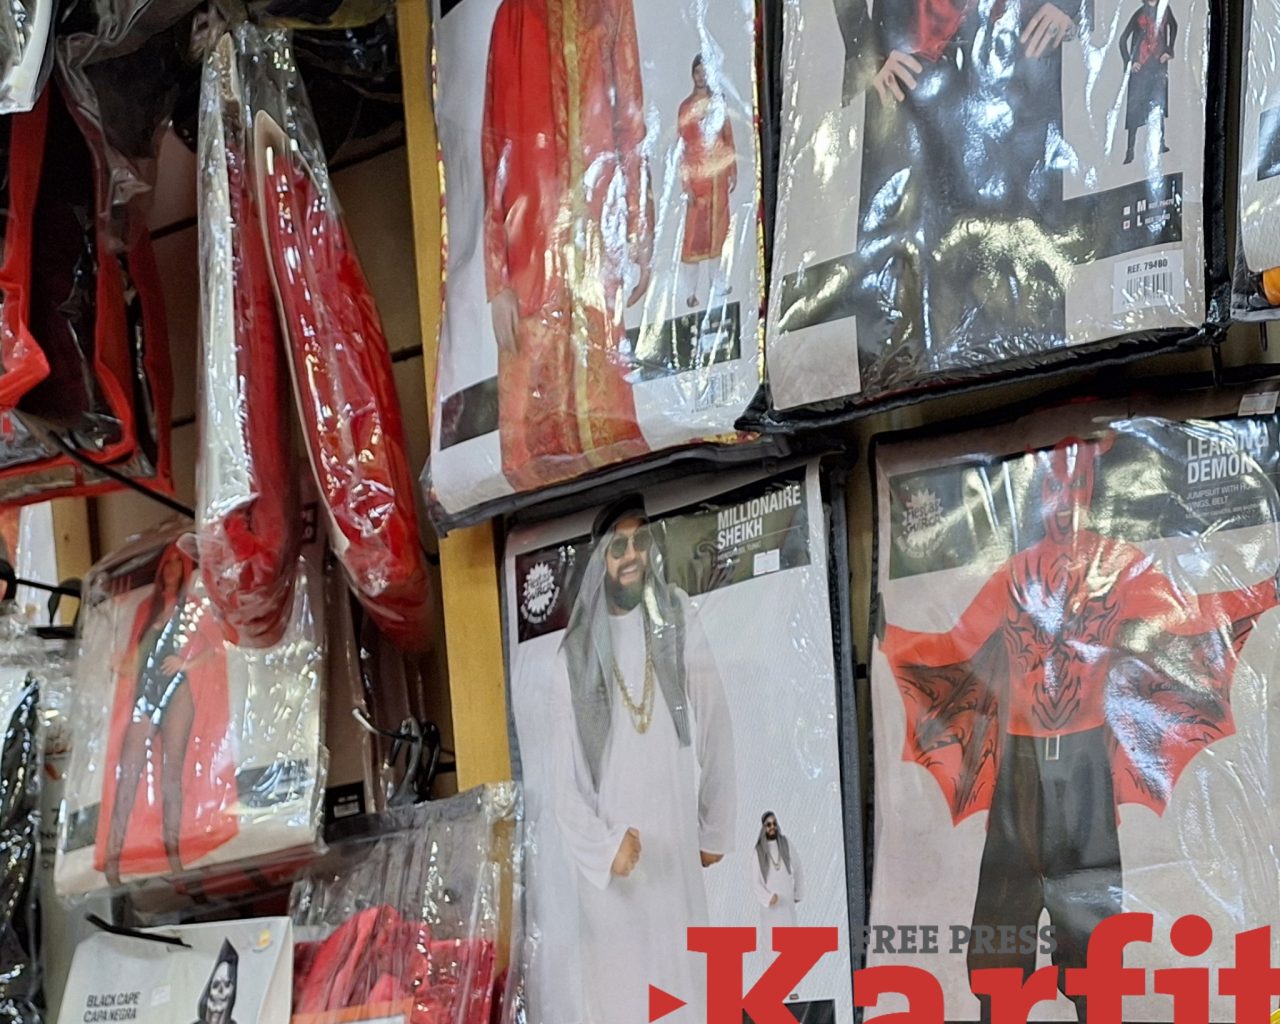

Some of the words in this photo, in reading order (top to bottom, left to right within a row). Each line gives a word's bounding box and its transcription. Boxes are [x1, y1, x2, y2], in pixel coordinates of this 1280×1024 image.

[1137, 200, 1146, 212] M
[1187, 454, 1254, 485] DEMON
[717, 485, 802, 531] MILLIONAIRE
[717, 516, 763, 549] SHEIKH
